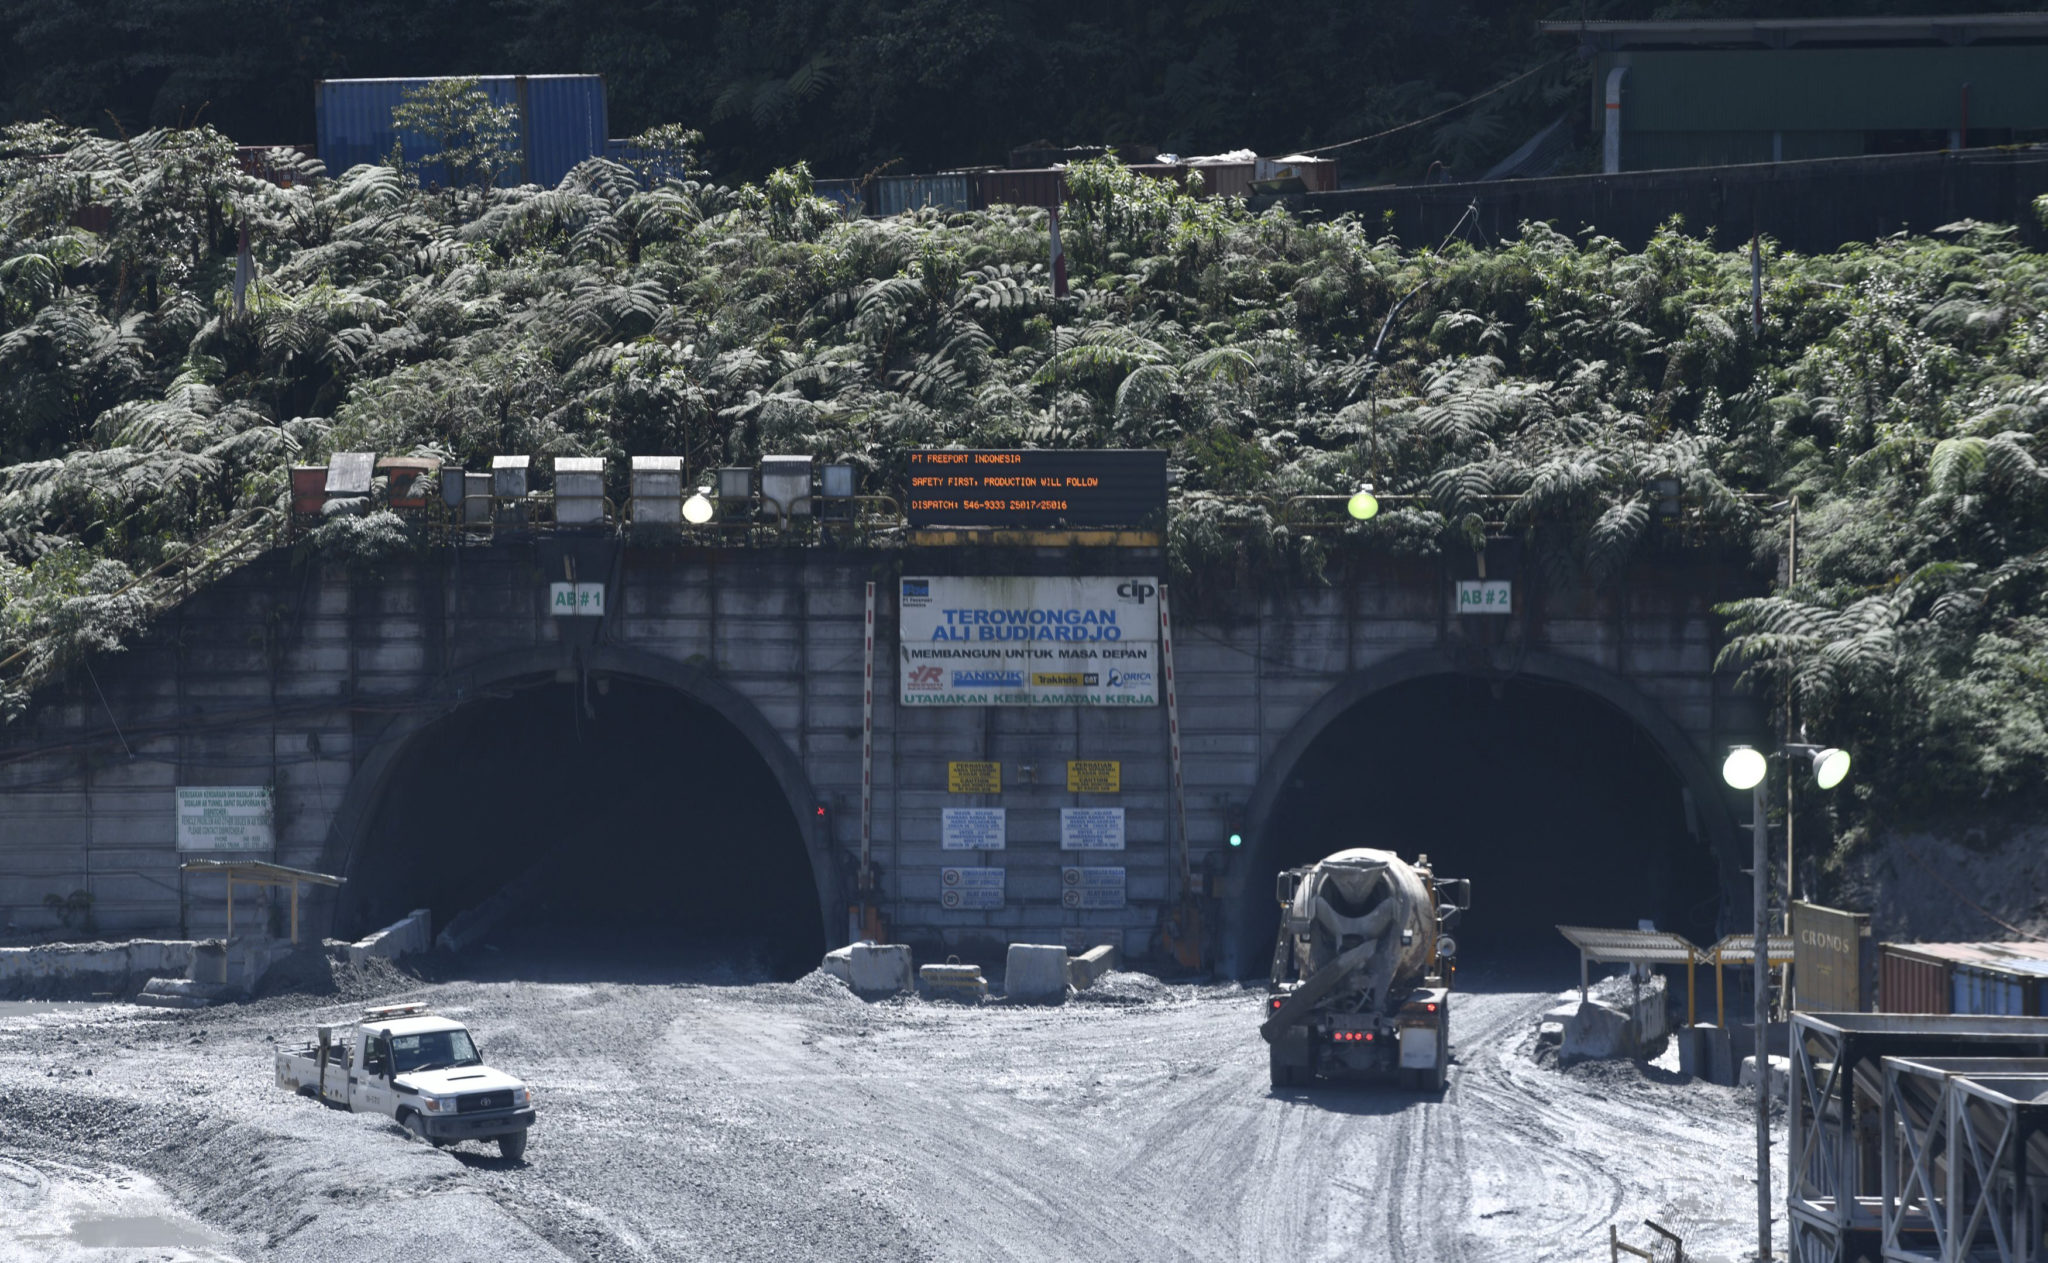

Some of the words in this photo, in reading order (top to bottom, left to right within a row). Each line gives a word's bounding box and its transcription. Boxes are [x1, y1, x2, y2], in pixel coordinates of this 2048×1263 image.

[911, 454, 922, 464] PT
[927, 454, 969, 464] FREEPORT
[974, 454, 1021, 464] INDONESIA
[911, 477, 944, 487] SAFETY
[983, 477, 1037, 487] PRODUCTION
[1040, 477, 1062, 487] WILL
[1066, 477, 1099, 487] FOLLOW
[911, 500, 959, 510] DISPATCH:
[963, 500, 1006, 510] 546-9333
[1116, 579, 1155, 604] cip
[1461, 589, 1482, 605] AB
[942, 609, 1117, 625] TEROWONGAN
[931, 626, 970, 641] ALI
[978, 626, 1122, 641] BUDIARDJO
[911, 649, 1001, 659] MEMBANGUN
[1005, 649, 1053, 659] UNTUK
[1058, 649, 1098, 659] MASA
[1102, 649, 1148, 659] DEPAN
[953, 671, 1022, 680] SANDVIK
[1038, 675, 1078, 686] Trakindo
[1122, 672, 1152, 681] ORICA
[904, 694, 988, 704] UTAMAKAN
[993, 694, 1101, 704] KESELAMATAN
[1106, 694, 1155, 704] KERJA
[1801, 929, 1850, 953] CRONOS
